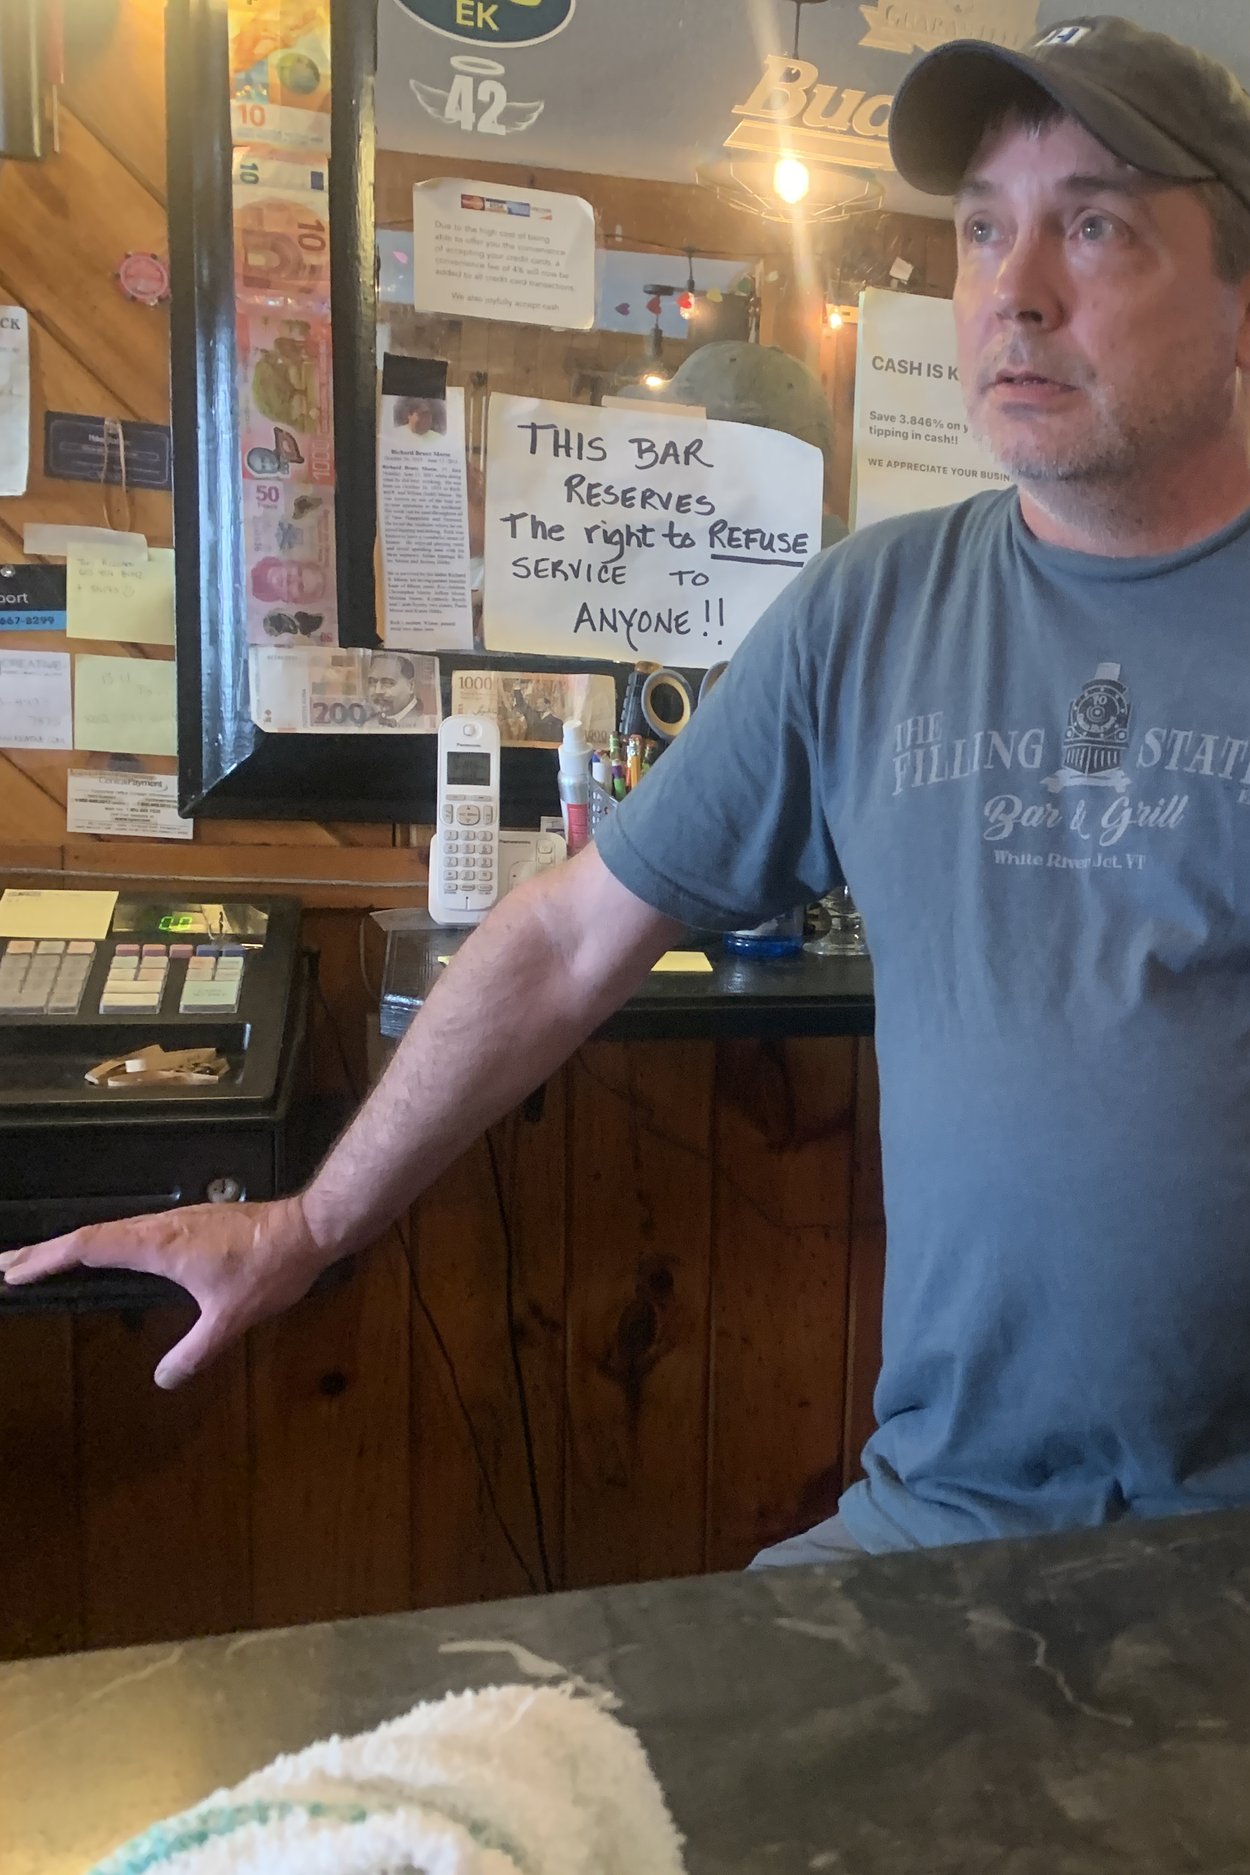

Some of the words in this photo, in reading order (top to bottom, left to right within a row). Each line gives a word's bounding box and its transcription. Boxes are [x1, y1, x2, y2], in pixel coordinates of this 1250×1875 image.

[239, 104, 266, 127] 10
[445, 74, 507, 135] 42
[240, 163, 260, 185] 10
[297, 218, 327, 251] 10
[871, 355, 922, 377] CASH
[926, 363, 944, 379] IS
[870, 411, 896, 423] Save
[899, 414, 944, 429] 3.846%
[947, 421, 961, 431] on
[518, 422, 607, 461] THIS
[628, 437, 715, 469] BAR
[869, 426, 908, 441] tipping
[911, 431, 922, 441] in
[924, 432, 959, 445] cash!!
[868, 458, 884, 468] WE
[886, 460, 948, 475] APPRECIATE
[950, 467, 978, 478] YOUR
[256, 486, 280, 503] 50
[564, 474, 716, 515] RESERVES
[500, 512, 565, 541] The
[584, 521, 655, 564] right
[662, 520, 696, 549] to
[709, 519, 809, 556] REFUSE
[512, 557, 627, 585] SERVICE
[669, 570, 710, 586] TO
[459, 677, 492, 690] 1000
[313, 702, 368, 726] 200
[895, 711, 943, 752] THE
[892, 728, 1045, 796] FILLING
[984, 795, 1062, 841] Bar
[1070, 800, 1090, 840] &
[1100, 795, 1189, 846] Grill
[994, 849, 1043, 866] White
